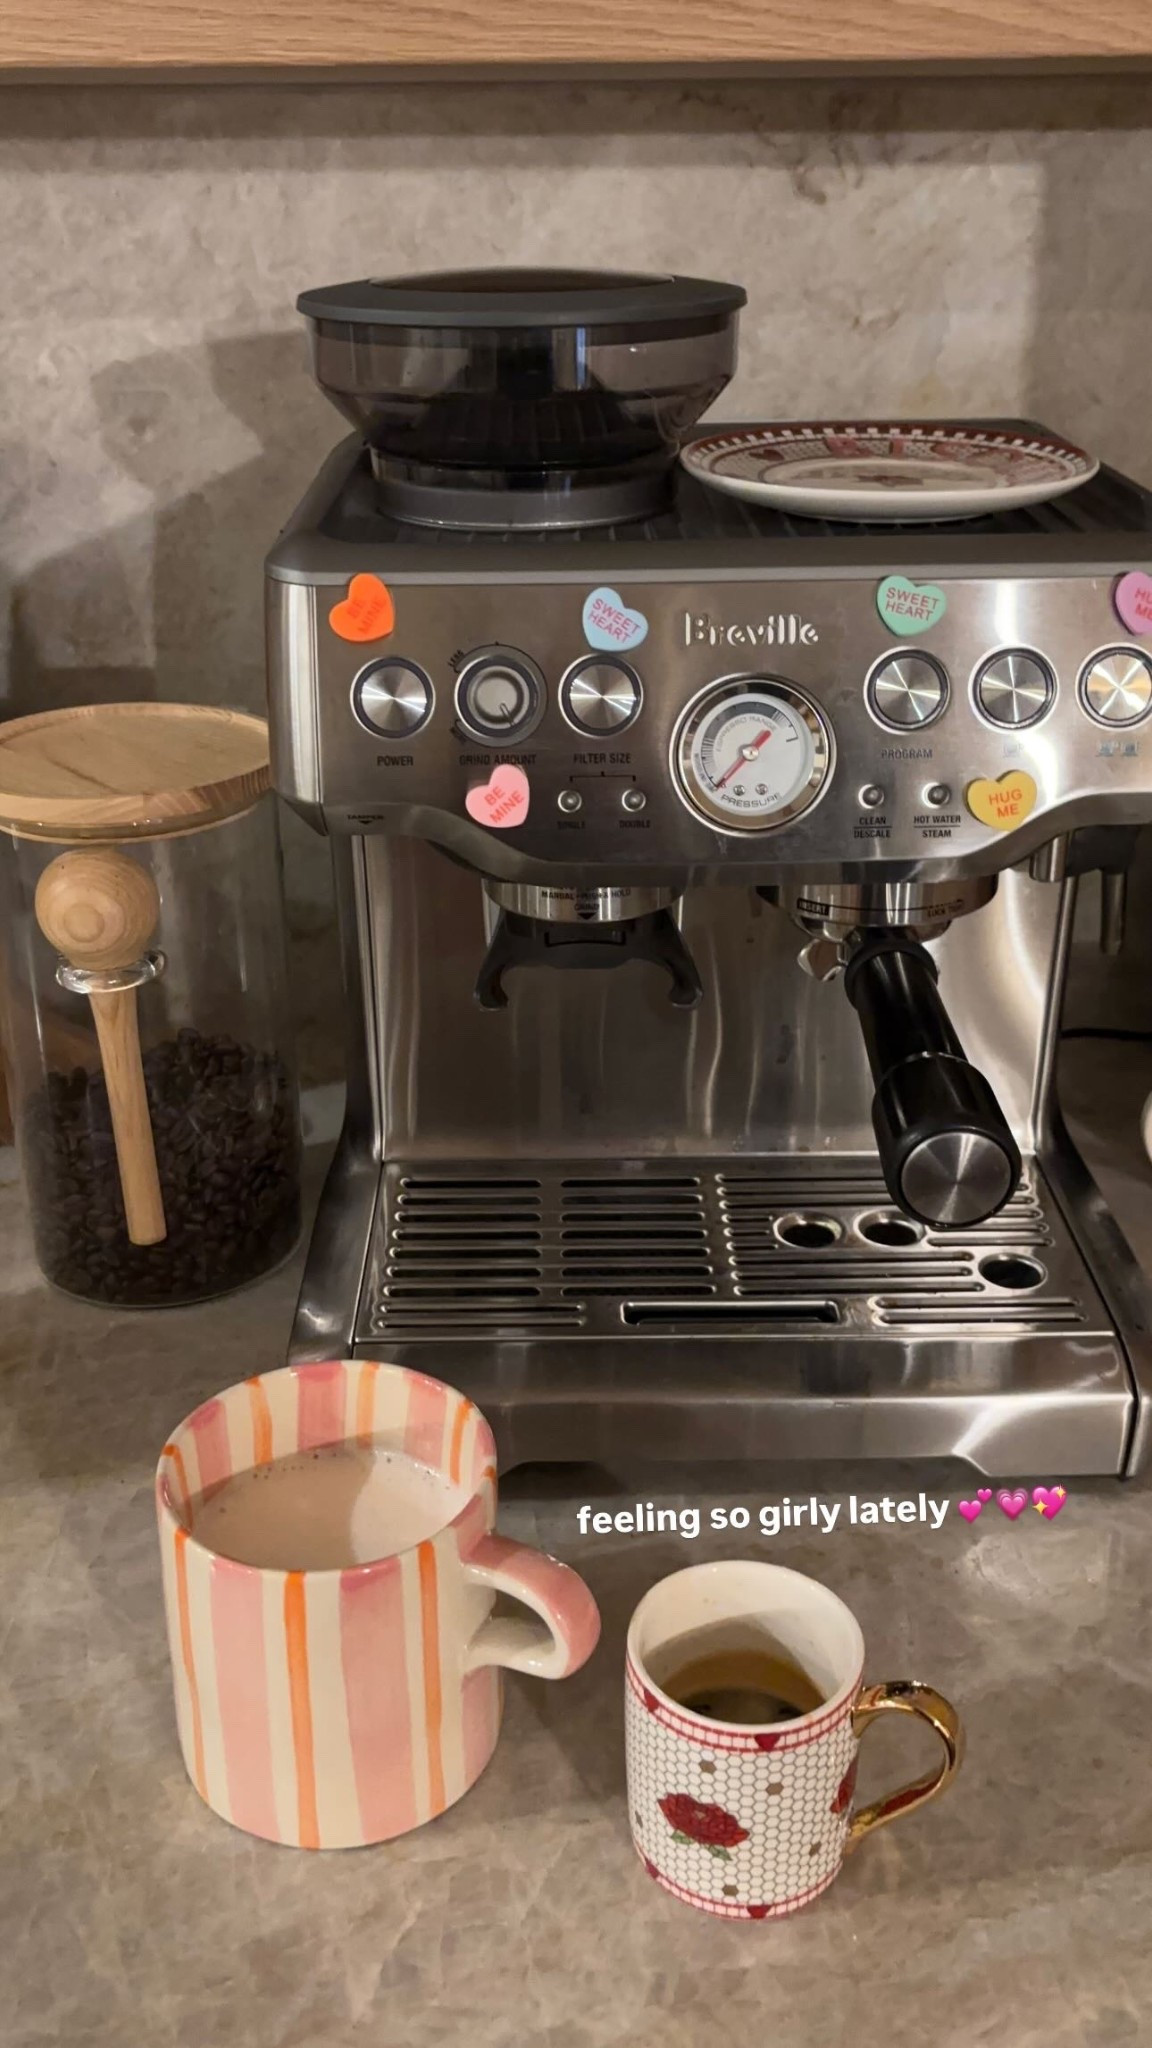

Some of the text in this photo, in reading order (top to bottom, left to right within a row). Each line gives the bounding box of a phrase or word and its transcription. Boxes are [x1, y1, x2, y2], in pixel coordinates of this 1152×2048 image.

[886, 587, 940, 610] SWEET
[346, 598, 367, 619] BE
[357, 599, 387, 634] MINE
[592, 598, 641, 633] SWEET
[884, 601, 934, 621] HEART
[587, 611, 632, 644] HEART
[684, 611, 819, 647] Breville
[377, 755, 414, 766] POWER
[459, 754, 537, 766] GRIND AMOUNT
[573, 753, 631, 764] FILTER SIZE
[881, 749, 933, 759] PROGRAM
[484, 786, 506, 806] BE
[721, 791, 783, 808] PRESSURE
[989, 788, 1022, 806] HUG
[489, 790, 524, 823] MINE
[997, 804, 1019, 818] ME
[859, 816, 887, 825] CLEAN
[913, 815, 961, 824] HOT WATER
[854, 830, 891, 838] DESCALE
[922, 830, 952, 838] STEAM
